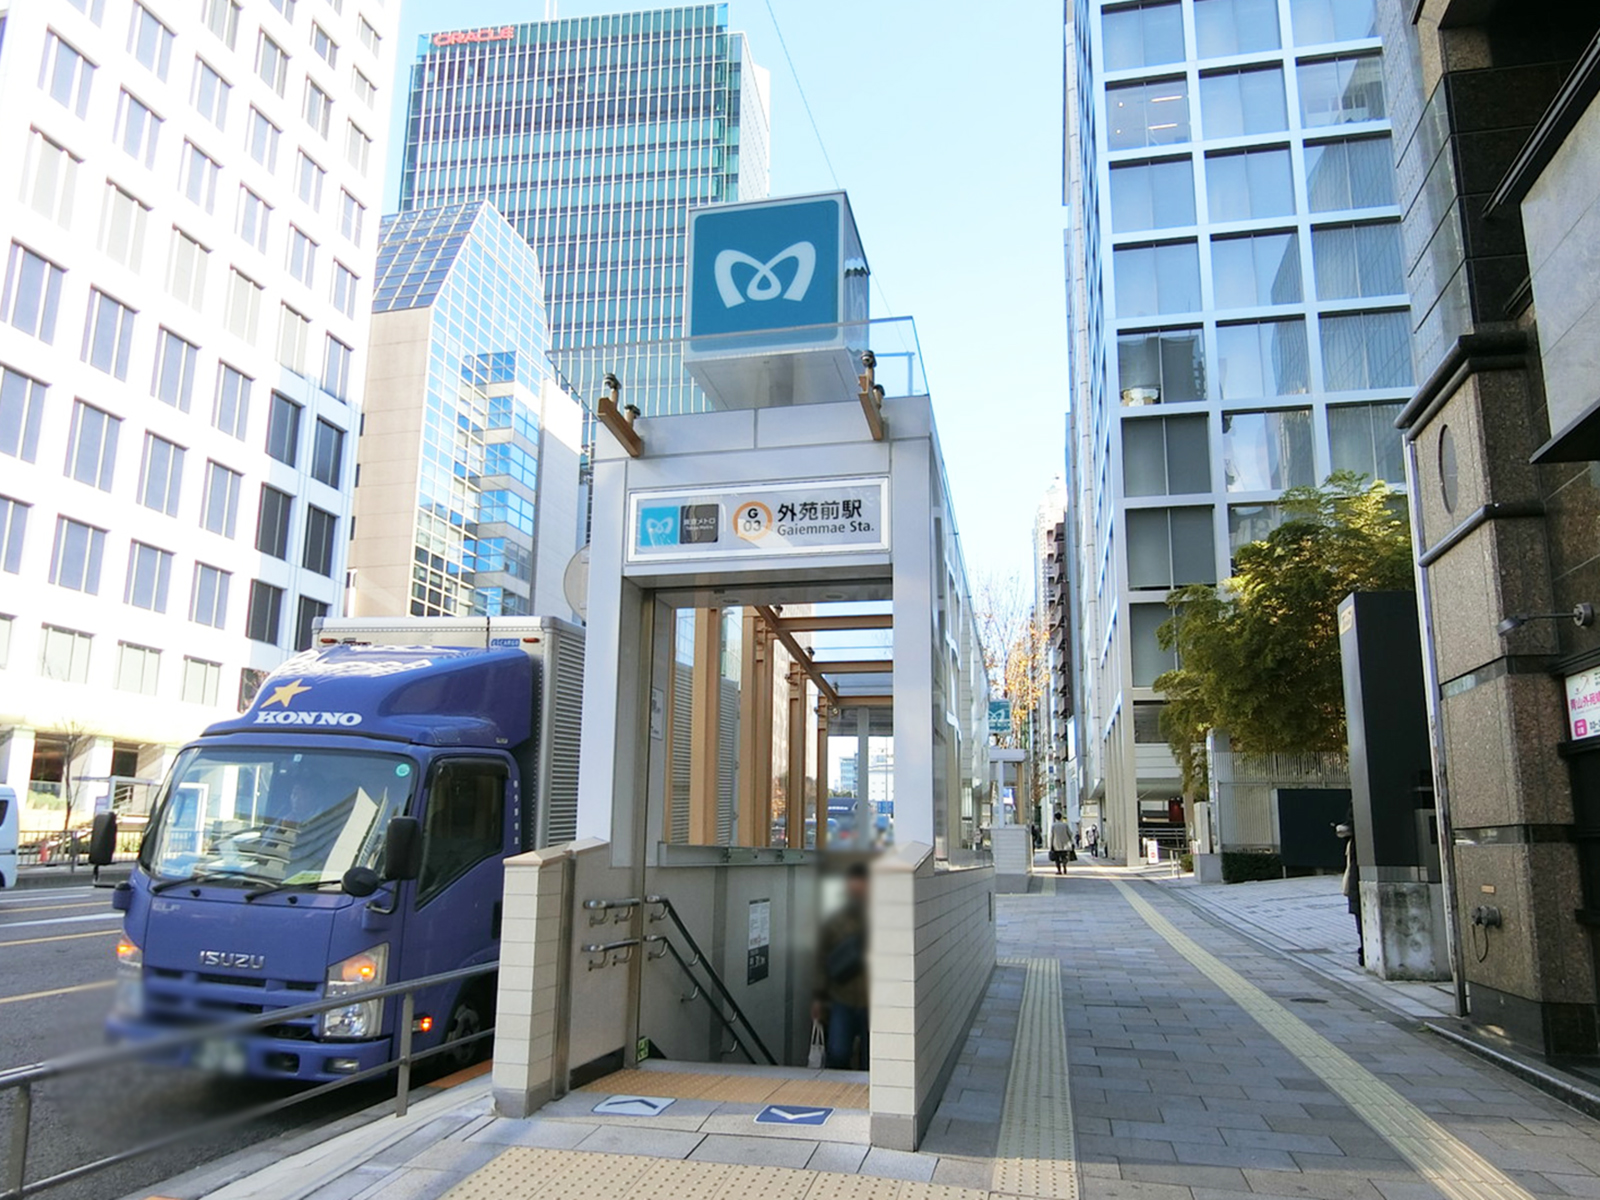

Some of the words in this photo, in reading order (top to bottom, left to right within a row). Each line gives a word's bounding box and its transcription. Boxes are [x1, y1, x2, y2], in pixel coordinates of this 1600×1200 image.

[433, 26, 514, 47] ORACLE
[747, 507, 758, 519] G
[777, 499, 862, 522] 外苑前駅
[743, 519, 761, 532] 03
[777, 523, 845, 536] Gaiemmae
[849, 520, 874, 533] Sta.
[253, 710, 362, 726] KONNO
[200, 950, 265, 969] ISUZU
